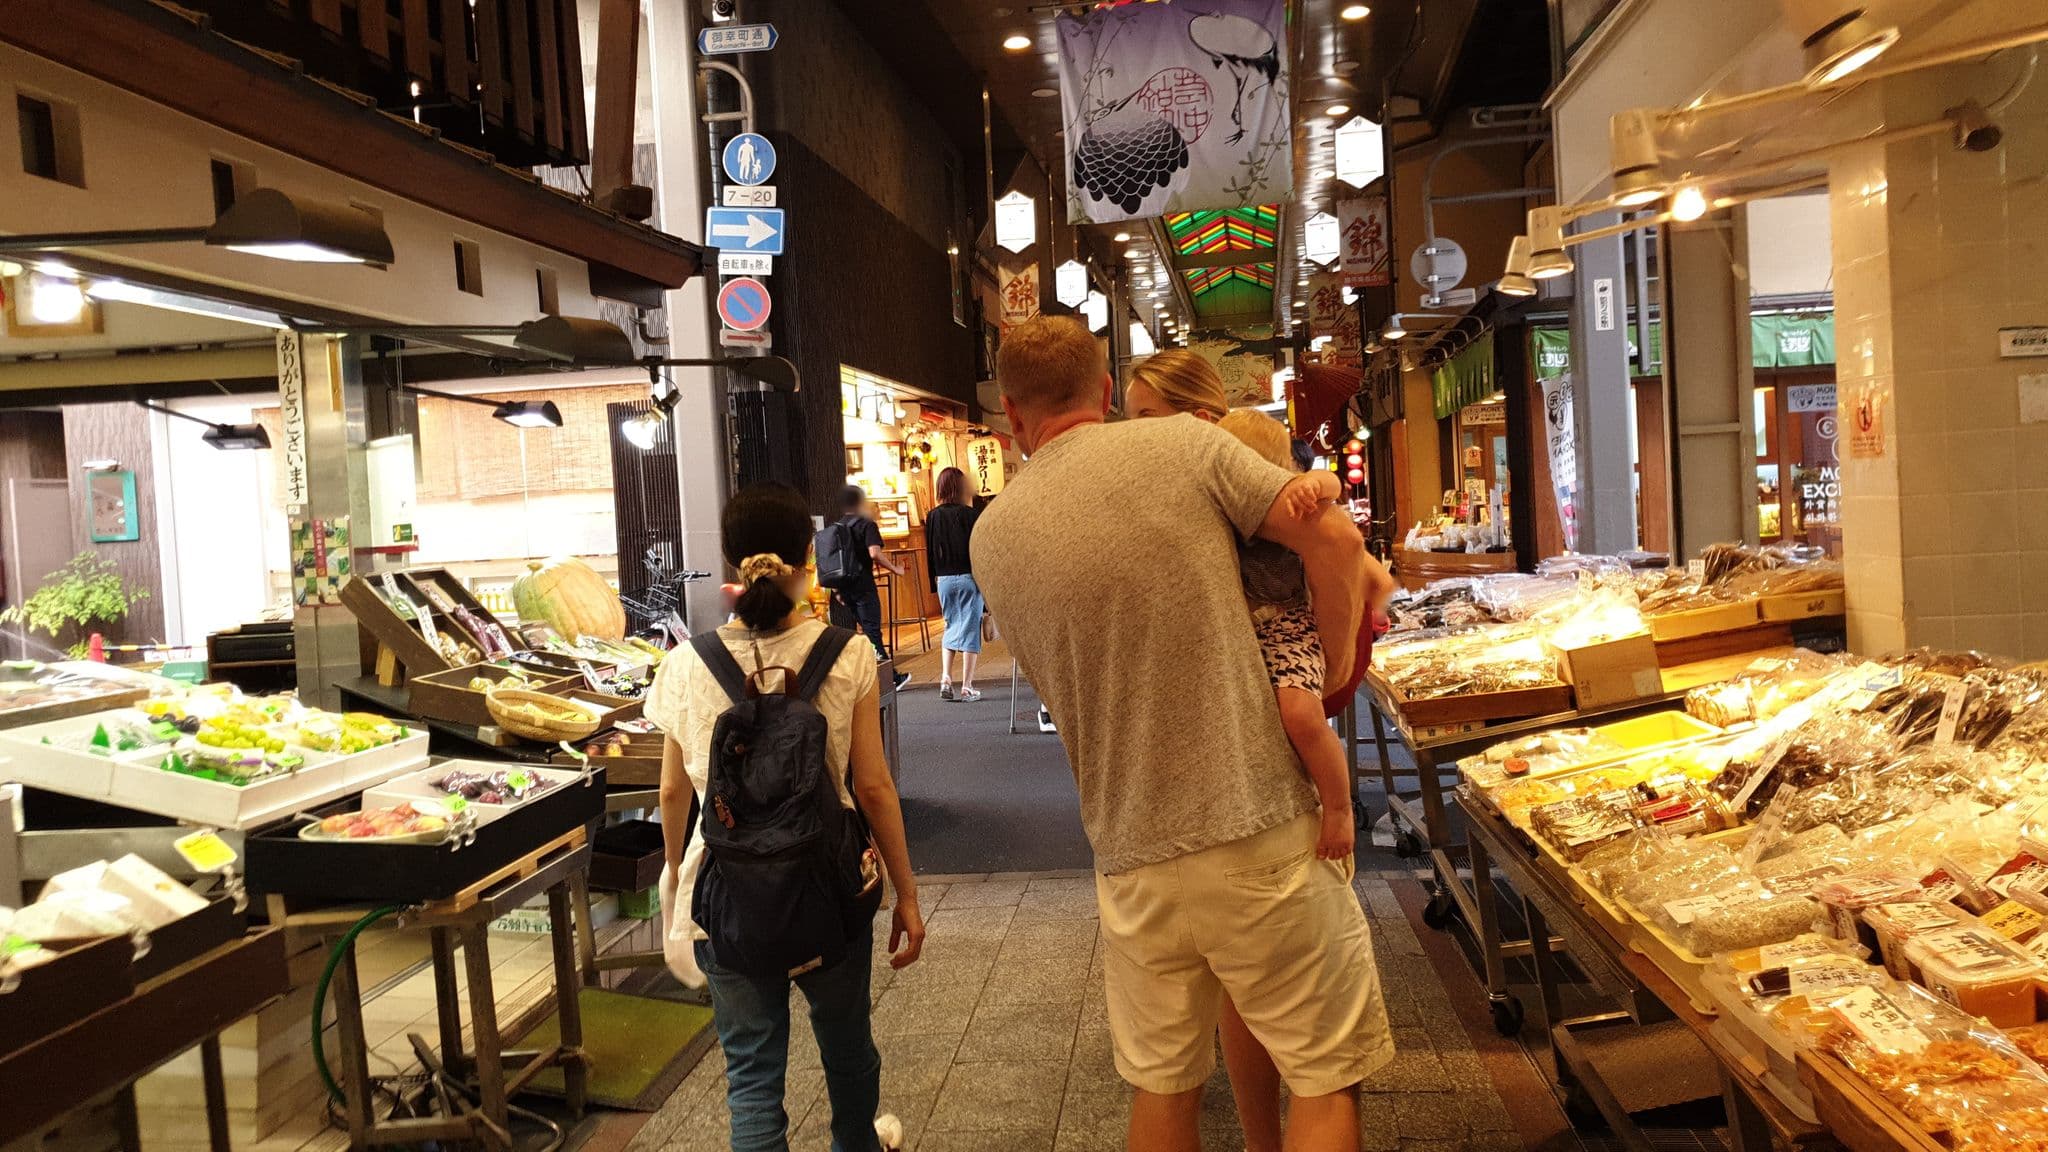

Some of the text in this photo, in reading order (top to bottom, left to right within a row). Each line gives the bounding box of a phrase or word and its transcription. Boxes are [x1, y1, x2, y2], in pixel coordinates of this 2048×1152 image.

[1342, 214, 1385, 265] 錦
[721, 258, 770, 272] 自転車を除く
[1002, 274, 1036, 318] 錦
[280, 334, 304, 501] ありがとうございます
[1803, 483, 1842, 498] EXC
